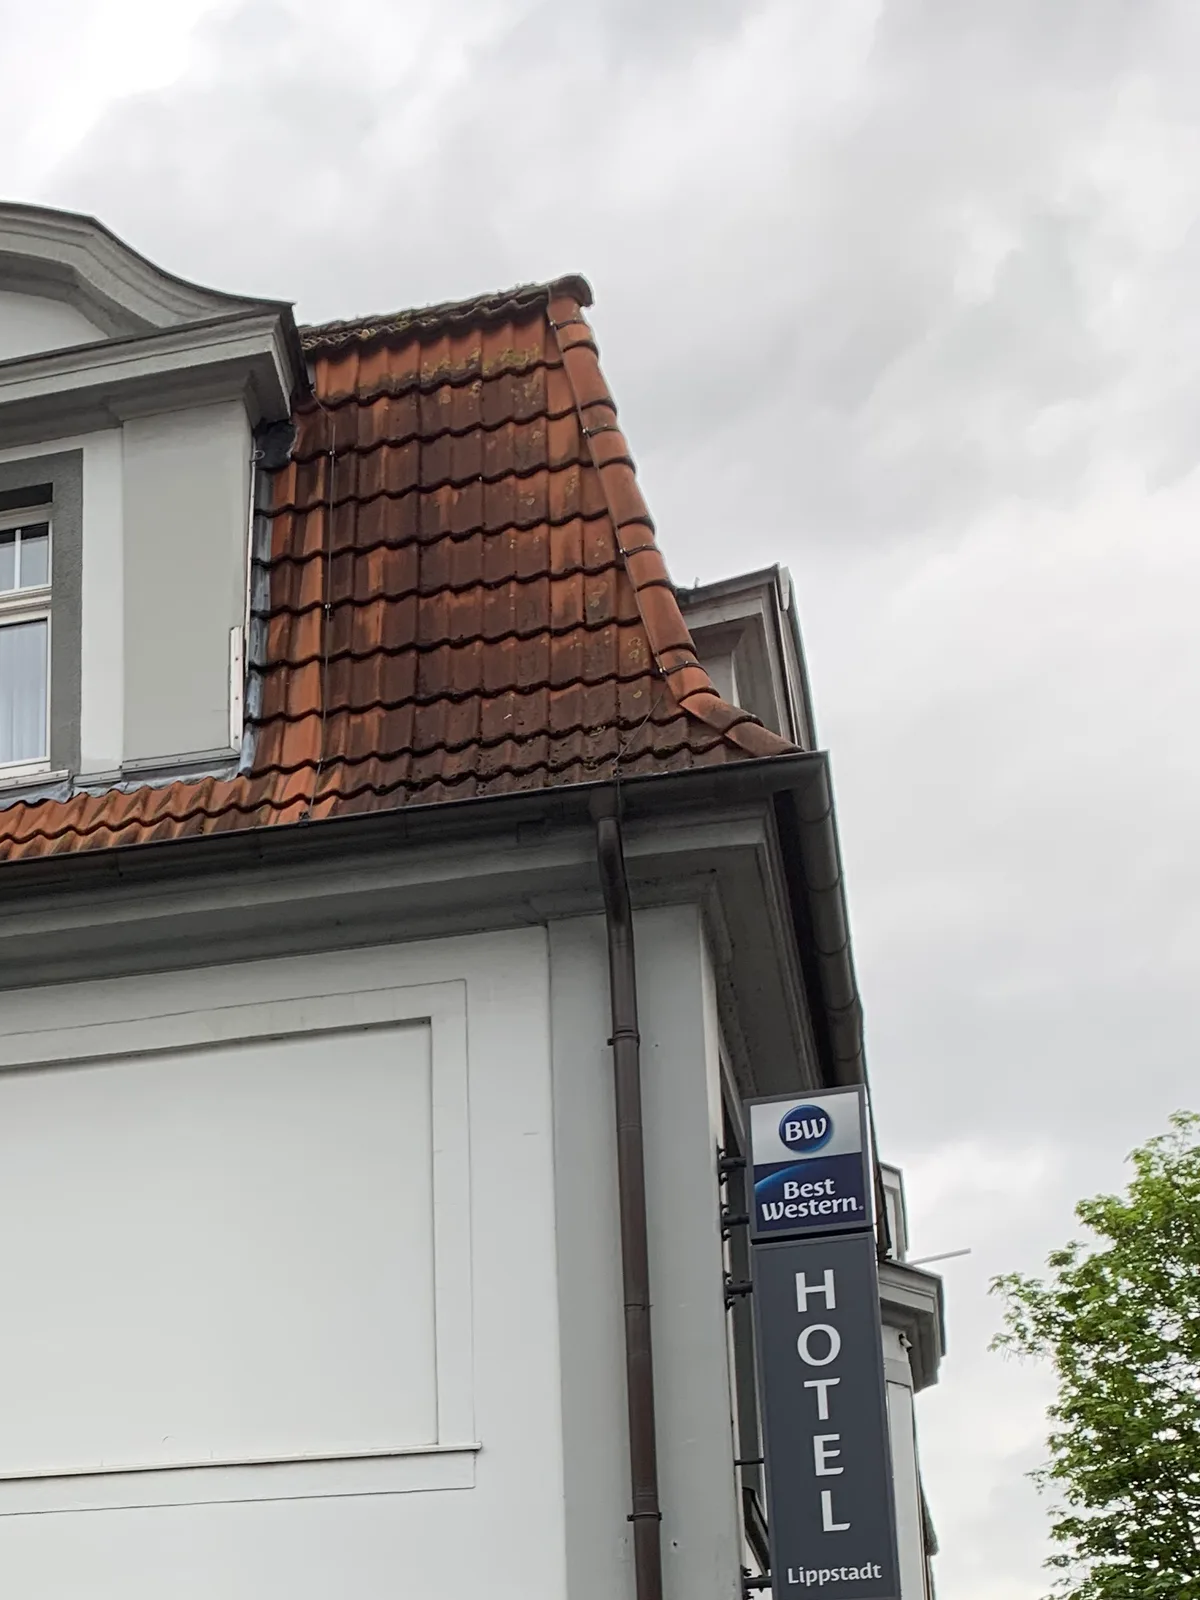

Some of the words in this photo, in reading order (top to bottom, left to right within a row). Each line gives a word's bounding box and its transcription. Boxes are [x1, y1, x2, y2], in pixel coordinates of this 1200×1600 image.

[785, 1117, 827, 1142] BW
[783, 1178, 836, 1200] Best
[761, 1196, 858, 1221] Western
[795, 1269, 851, 1532] HOTEL
[787, 1562, 883, 1587] Lippstadt
